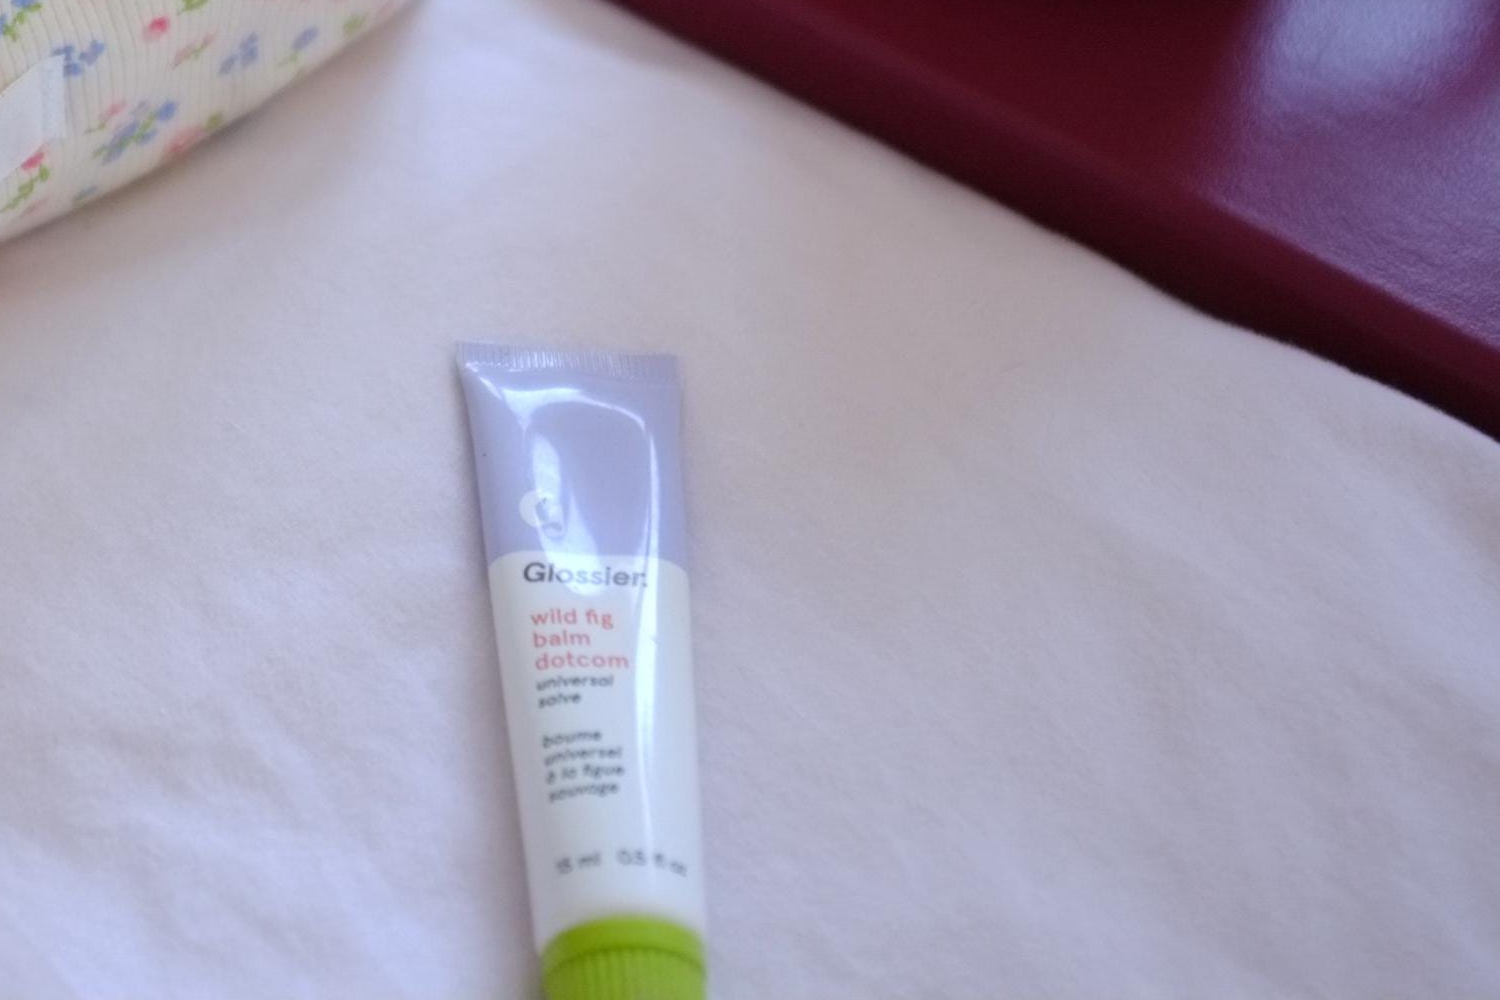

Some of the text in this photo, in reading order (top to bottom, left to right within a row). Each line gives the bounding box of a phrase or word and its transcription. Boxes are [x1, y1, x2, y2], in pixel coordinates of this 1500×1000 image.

[531, 608, 614, 629] wild fig
[533, 630, 590, 648] balm
[535, 652, 629, 671] dotcom
[536, 674, 614, 691] universal
